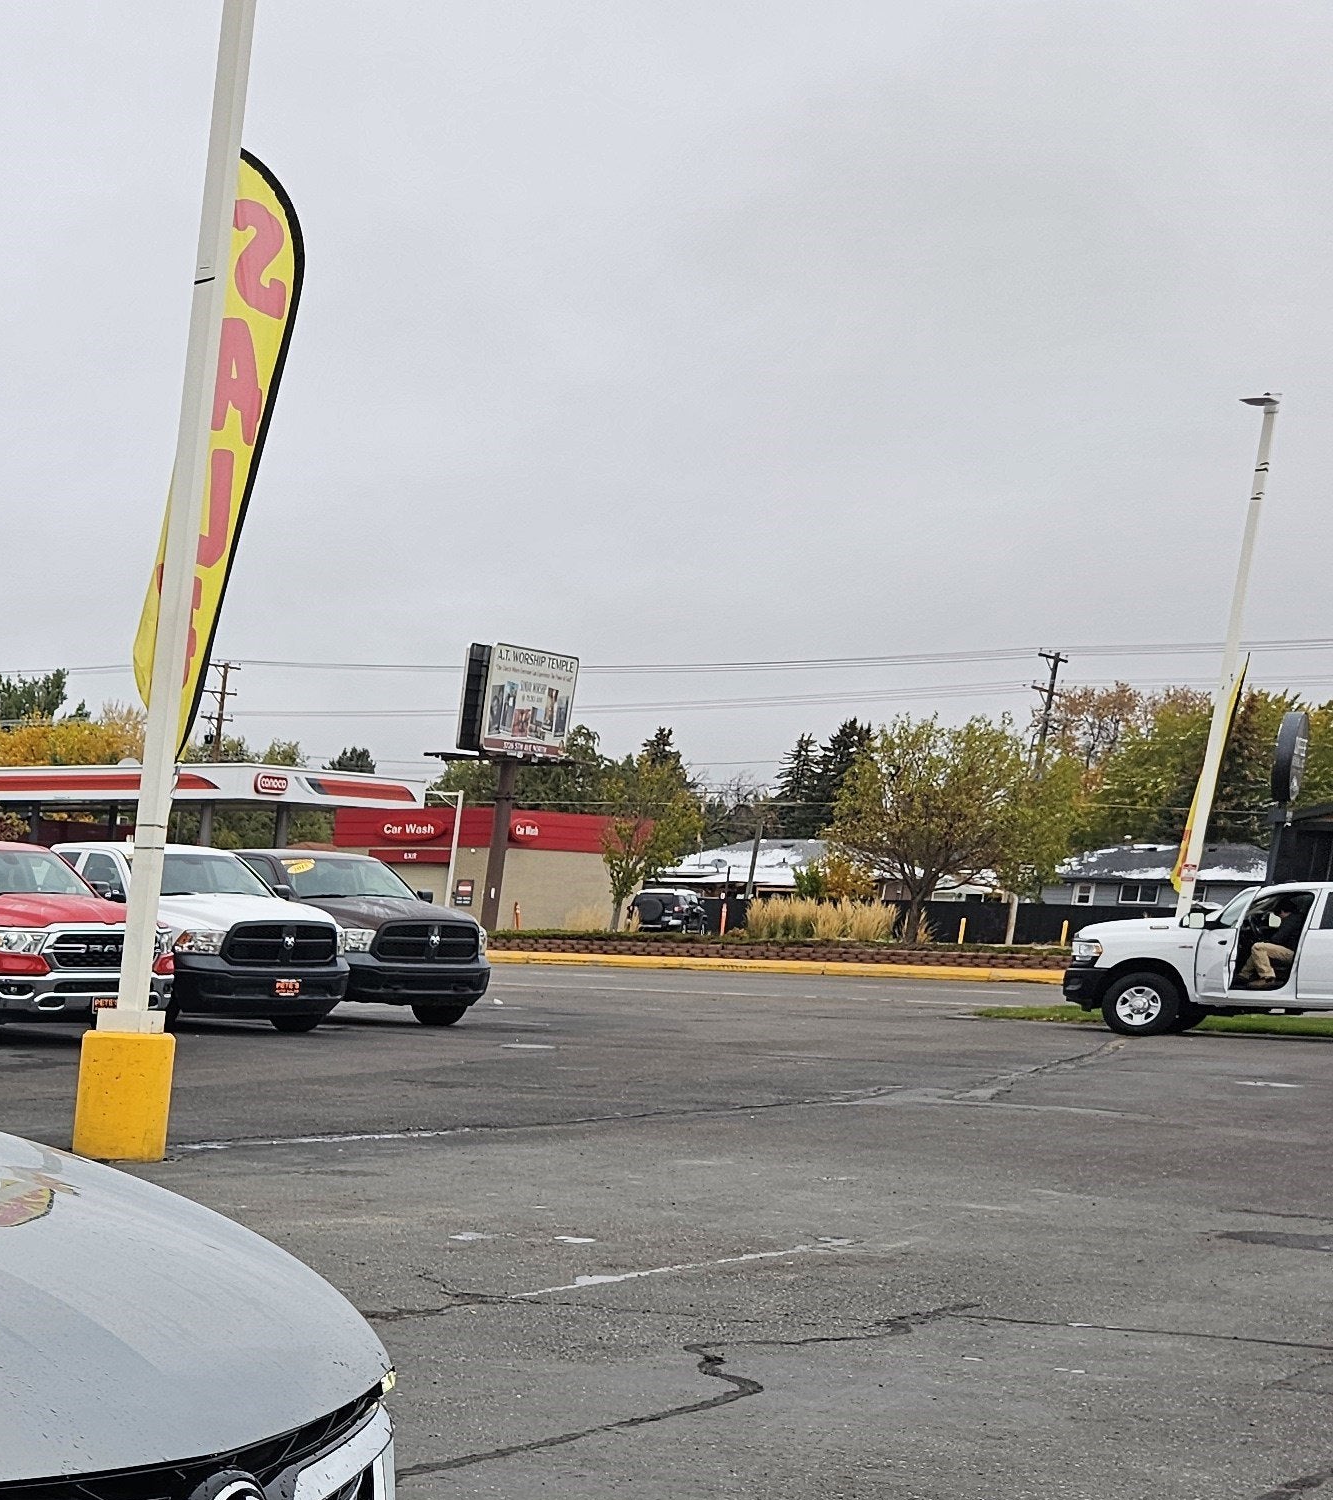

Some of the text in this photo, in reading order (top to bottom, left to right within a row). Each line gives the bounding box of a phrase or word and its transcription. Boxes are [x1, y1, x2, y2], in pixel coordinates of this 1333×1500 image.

[513, 651, 546, 667] WORSHIP
[548, 657, 575, 673] TEMPLE
[261, 777, 287, 789] conoco
[384, 823, 434, 835] Car Wash
[516, 825, 525, 834] Car
